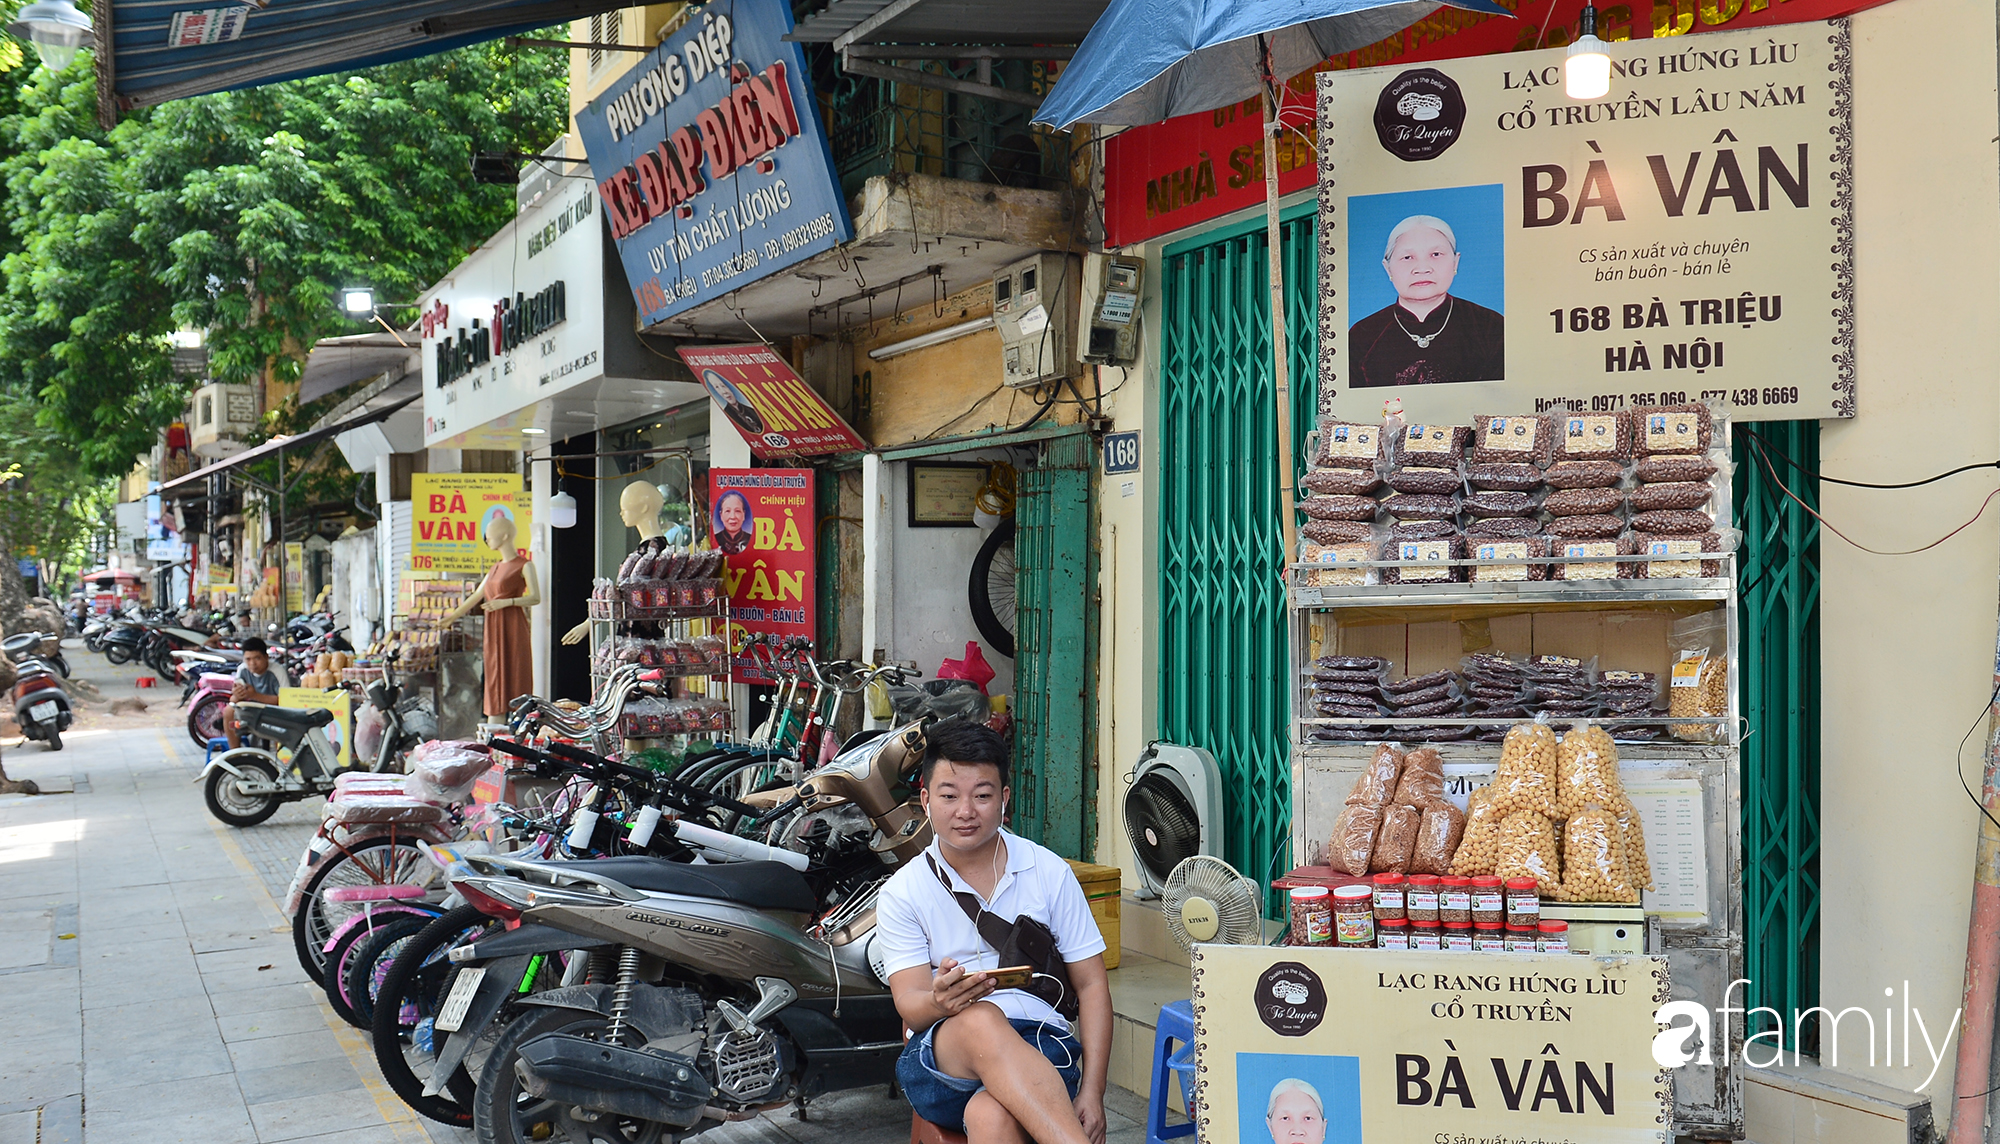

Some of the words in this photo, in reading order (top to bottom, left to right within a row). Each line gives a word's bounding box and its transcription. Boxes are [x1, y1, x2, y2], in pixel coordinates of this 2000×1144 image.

[606, 55, 688, 143] PHƯƠNG
[683, 12, 733, 83] DIỆP
[1502, 66, 1560, 93] LẠC
[1658, 46, 1740, 75] HÚNG
[1749, 38, 1800, 66] LÌU
[1391, 80, 1413, 96] Quality
[1430, 78, 1447, 91] belief
[1497, 99, 1537, 131] CỔ
[1545, 90, 1662, 127] TRUYỀN
[1670, 88, 1731, 116] LÂU
[1738, 81, 1807, 110] NĂM
[599, 163, 652, 240] XE
[634, 122, 706, 220] ĐẠP
[696, 59, 801, 180] ĐIỆN
[1146, 151, 1218, 220] NHÀ
[1521, 140, 1627, 229] BÀ
[1646, 128, 1810, 218] VÂN
[558, 199, 574, 238] XUẤT
[575, 182, 593, 225] KHẨU
[647, 243, 669, 274] UY
[666, 230, 690, 264] TÍN
[690, 202, 731, 251] CHẤT
[730, 179, 792, 232] LƯỢNG
[635, 276, 667, 318] 168
[764, 238, 784, 261] DĐ:
[782, 212, 836, 254] 0903219985
[1578, 248, 1598, 264] CS
[1600, 246, 1628, 262] sản
[1631, 240, 1667, 260] xuất
[1670, 241, 1689, 257] và
[1692, 238, 1751, 259] chuyên
[1594, 265, 1624, 282] bán
[1628, 264, 1668, 280] buôn
[1682, 260, 1712, 277] bán
[1716, 257, 1732, 275] lẻ
[1550, 305, 1611, 334] 168
[1622, 296, 1670, 329] BÀ
[1680, 291, 1782, 329] TRIỆU
[1605, 340, 1651, 373] HÀ
[1662, 336, 1724, 374] NỘI
[760, 364, 840, 430] VÂN
[1591, 394, 1625, 411] 0971
[1731, 388, 1758, 406] 438
[1762, 386, 1799, 405] 6669
[1107, 438, 1137, 467] 168
[716, 474, 728, 489] LẠC
[728, 475, 744, 488] RANG
[744, 473, 760, 488] HÚNG
[773, 475, 783, 488] GIA
[783, 473, 806, 489] TRUYỀN
[429, 490, 467, 514] BÀ
[760, 494, 786, 505] CHÍNH
[787, 494, 806, 507] HIỆU
[418, 516, 476, 541] VÂN
[753, 508, 806, 551] BÀ
[413, 555, 432, 569] 176
[726, 559, 806, 602] VÂN
[739, 605, 765, 621] BUÔN
[772, 607, 792, 623] BÁN
[625, 911, 661, 926] AIR
[665, 918, 732, 938] BLADE
[1267, 969, 1284, 982] Quality
[1298, 970, 1312, 982] belief
[1377, 972, 1426, 993] LẠC
[1433, 974, 1501, 992] RANG
[1508, 972, 1577, 994] HÚNG
[1585, 974, 1628, 995] LÌU
[1430, 994, 1464, 1019] CỔ
[1472, 997, 1573, 1023] TRUYỀN
[1395, 1038, 1477, 1110] BÀ
[1490, 1042, 1616, 1116] VÂN
[1434, 1132, 1450, 1144] CS
[1453, 1132, 1475, 1144] sản
